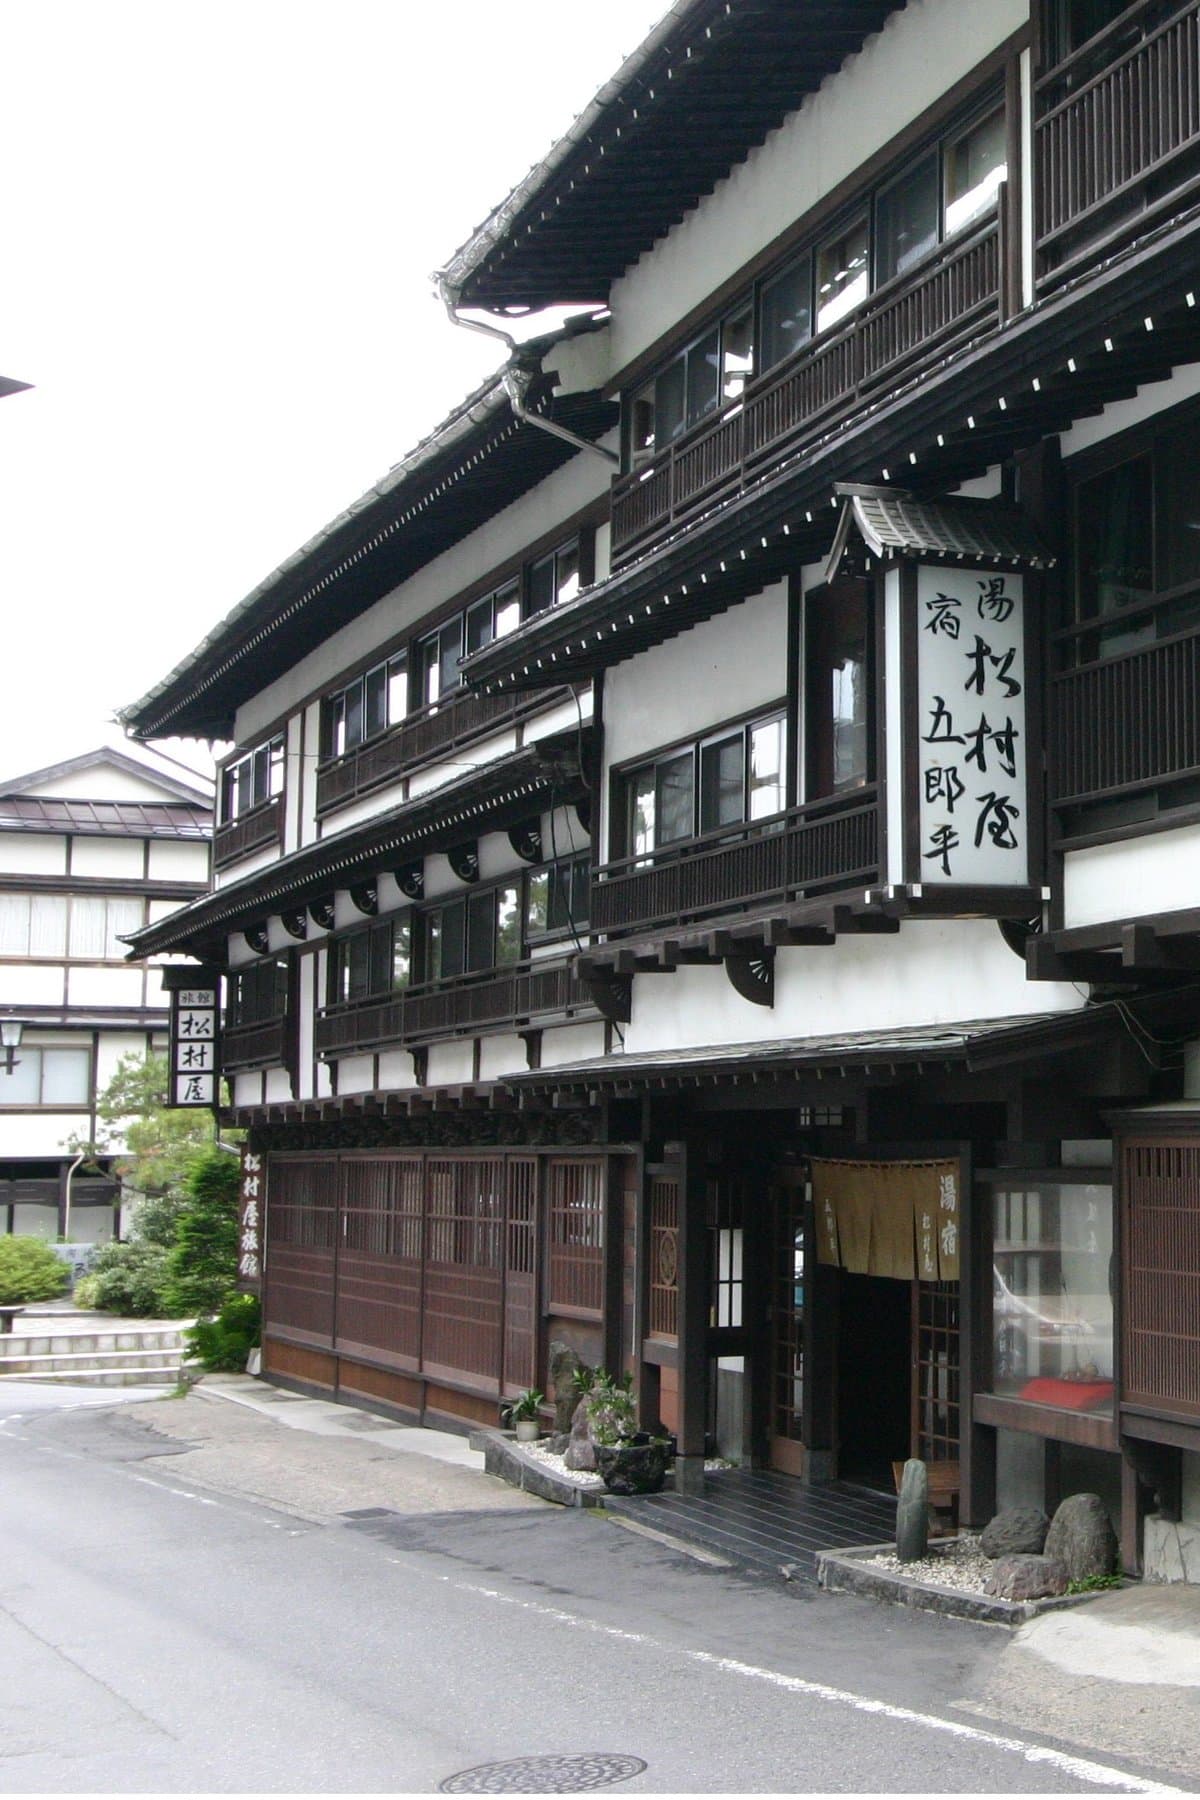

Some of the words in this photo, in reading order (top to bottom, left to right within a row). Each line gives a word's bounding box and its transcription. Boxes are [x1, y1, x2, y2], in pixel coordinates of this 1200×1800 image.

[921, 695, 967, 877] 五郎平
[964, 633, 1022, 850] 松村屋
[181, 1011, 211, 1101] 松村屋
[240, 1153, 261, 1277] 松村屋旅館
[940, 1174, 957, 1256] 湯宿
